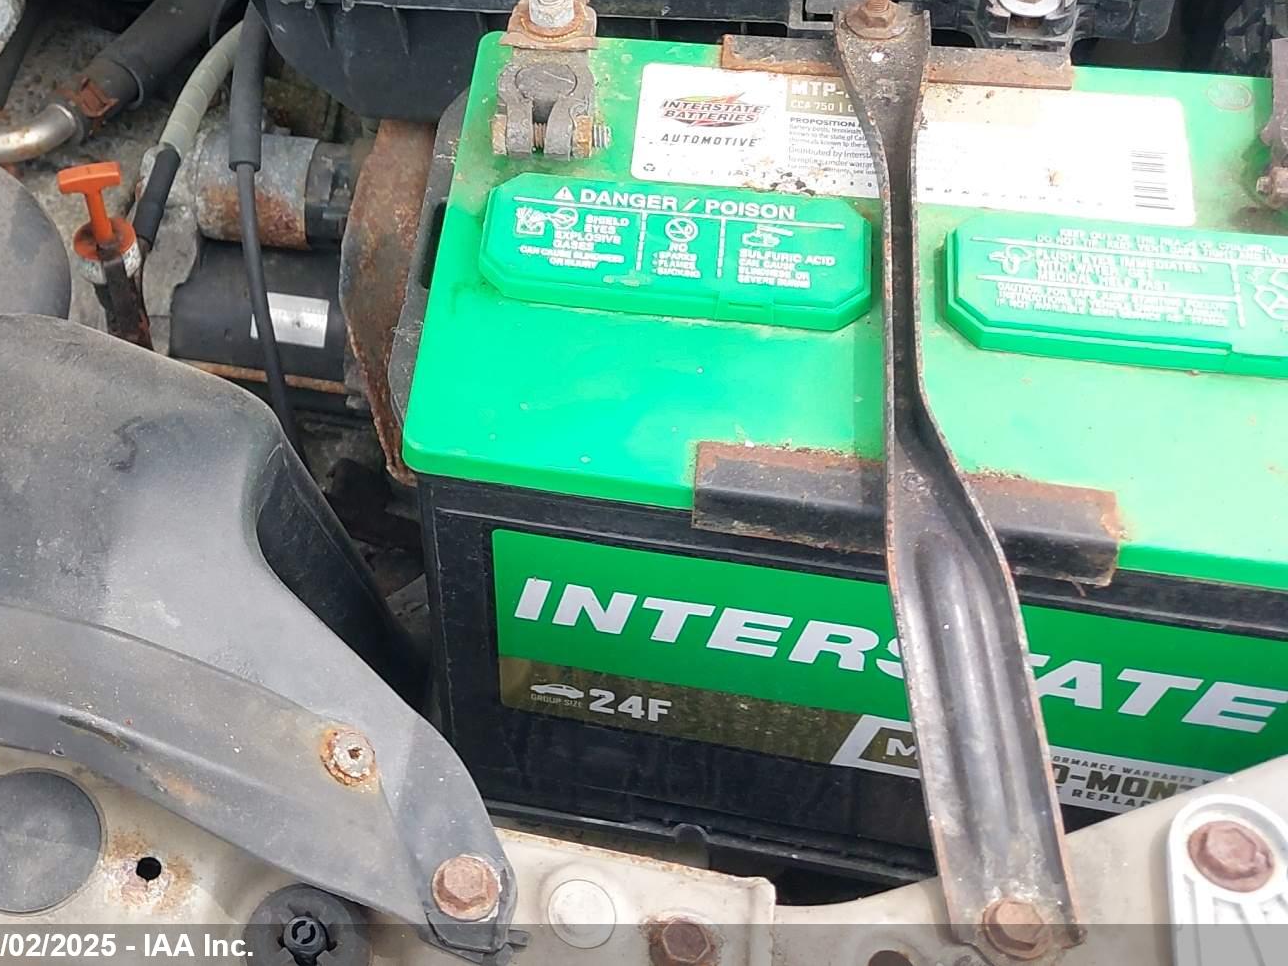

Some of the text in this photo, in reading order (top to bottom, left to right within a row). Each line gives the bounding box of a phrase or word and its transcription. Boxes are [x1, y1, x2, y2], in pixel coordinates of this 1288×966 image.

[662, 99, 765, 116] INTERSTATE
[813, 101, 835, 112] 750
[663, 110, 759, 123] BATTERIES
[789, 117, 856, 128] PROPOSITION
[661, 132, 759, 148] AUTOMOTIVE
[832, 150, 842, 160] by
[579, 189, 678, 211] DANGER
[705, 199, 796, 220] POISON
[585, 214, 630, 227] SHIELD
[583, 224, 616, 236] EYES
[554, 230, 621, 246] EXPLOSIVE
[1036, 234, 1052, 244] DO
[1055, 236, 1075, 246] NOT
[552, 240, 595, 252] GASES
[669, 242, 688, 253] NO
[739, 248, 837, 266] SULFURIC ACID
[1035, 248, 1075, 262] FLUSH
[1036, 270, 1088, 285] MEDICAL
[530, 693, 584, 708] GROUP SIZE
[588, 688, 673, 722] 24F
[1050, 754, 1116, 772] ORMANCE
